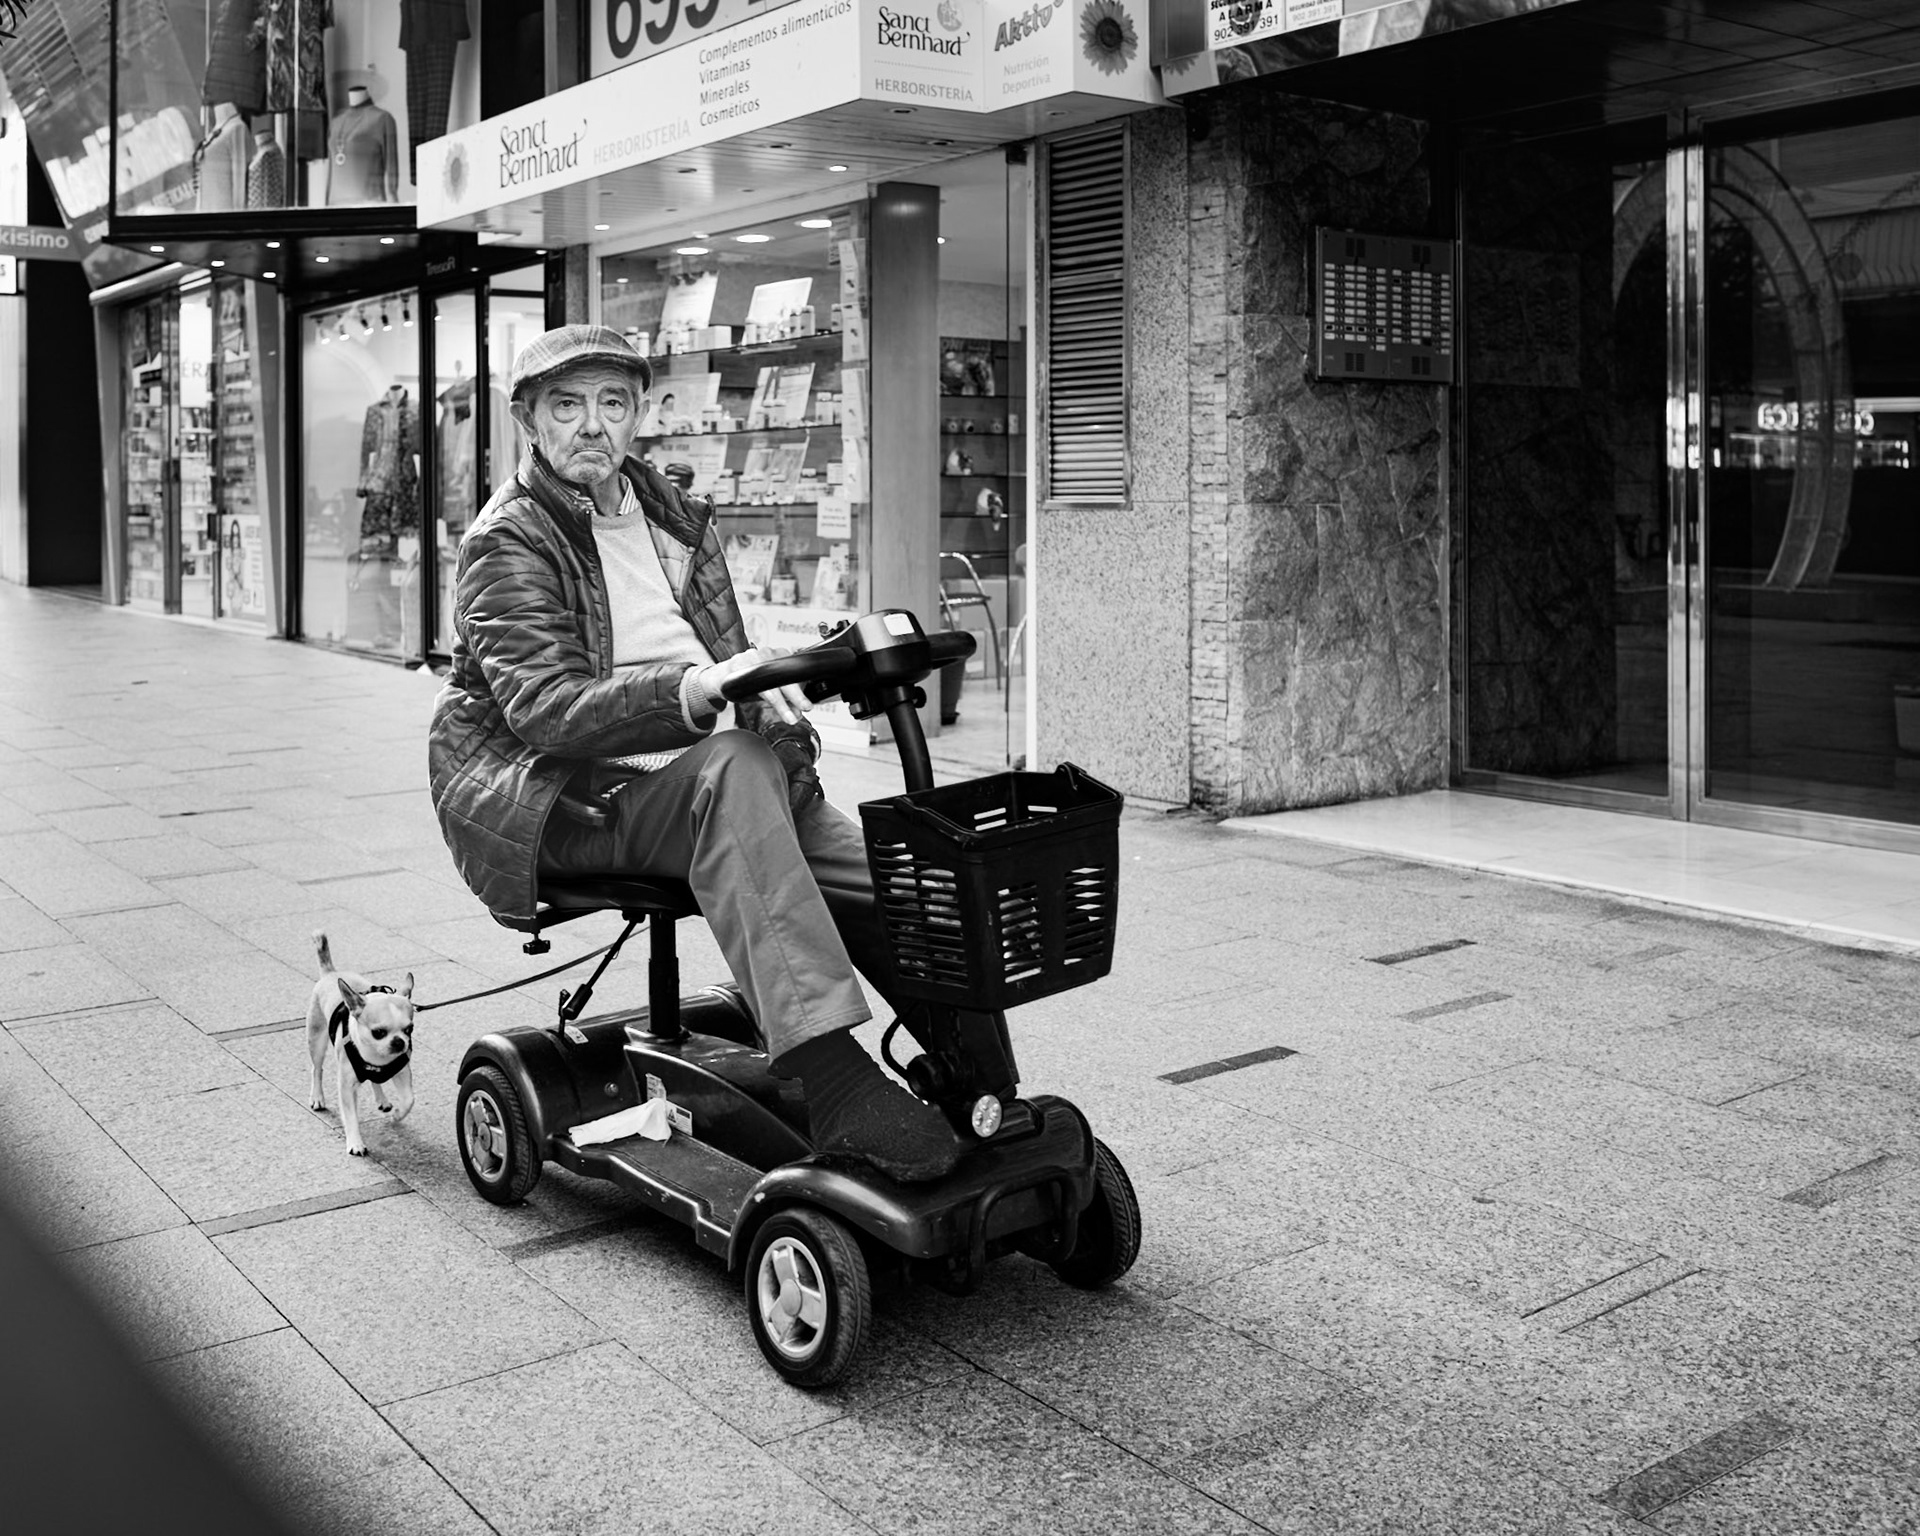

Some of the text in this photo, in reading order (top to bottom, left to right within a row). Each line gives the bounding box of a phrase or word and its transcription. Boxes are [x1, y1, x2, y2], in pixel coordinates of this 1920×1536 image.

[699, 0, 853, 64] Complementos alimenticios
[878, 6, 931, 34] Sanct
[1214, 26, 1233, 41] 902
[1237, 22, 1255, 35] 391
[1259, 14, 1279, 29] 391
[699, 57, 751, 85] Vitaminas
[1003, 55, 1050, 76] Nutrición
[699, 79, 751, 106] Minerales
[875, 77, 974, 102] HERBORISTERÍA
[1002, 74, 1051, 95] Deportiva
[699, 97, 761, 127] Cosméticos
[500, 116, 548, 156] Sanct
[593, 117, 692, 166] HERBORISTERÍA
